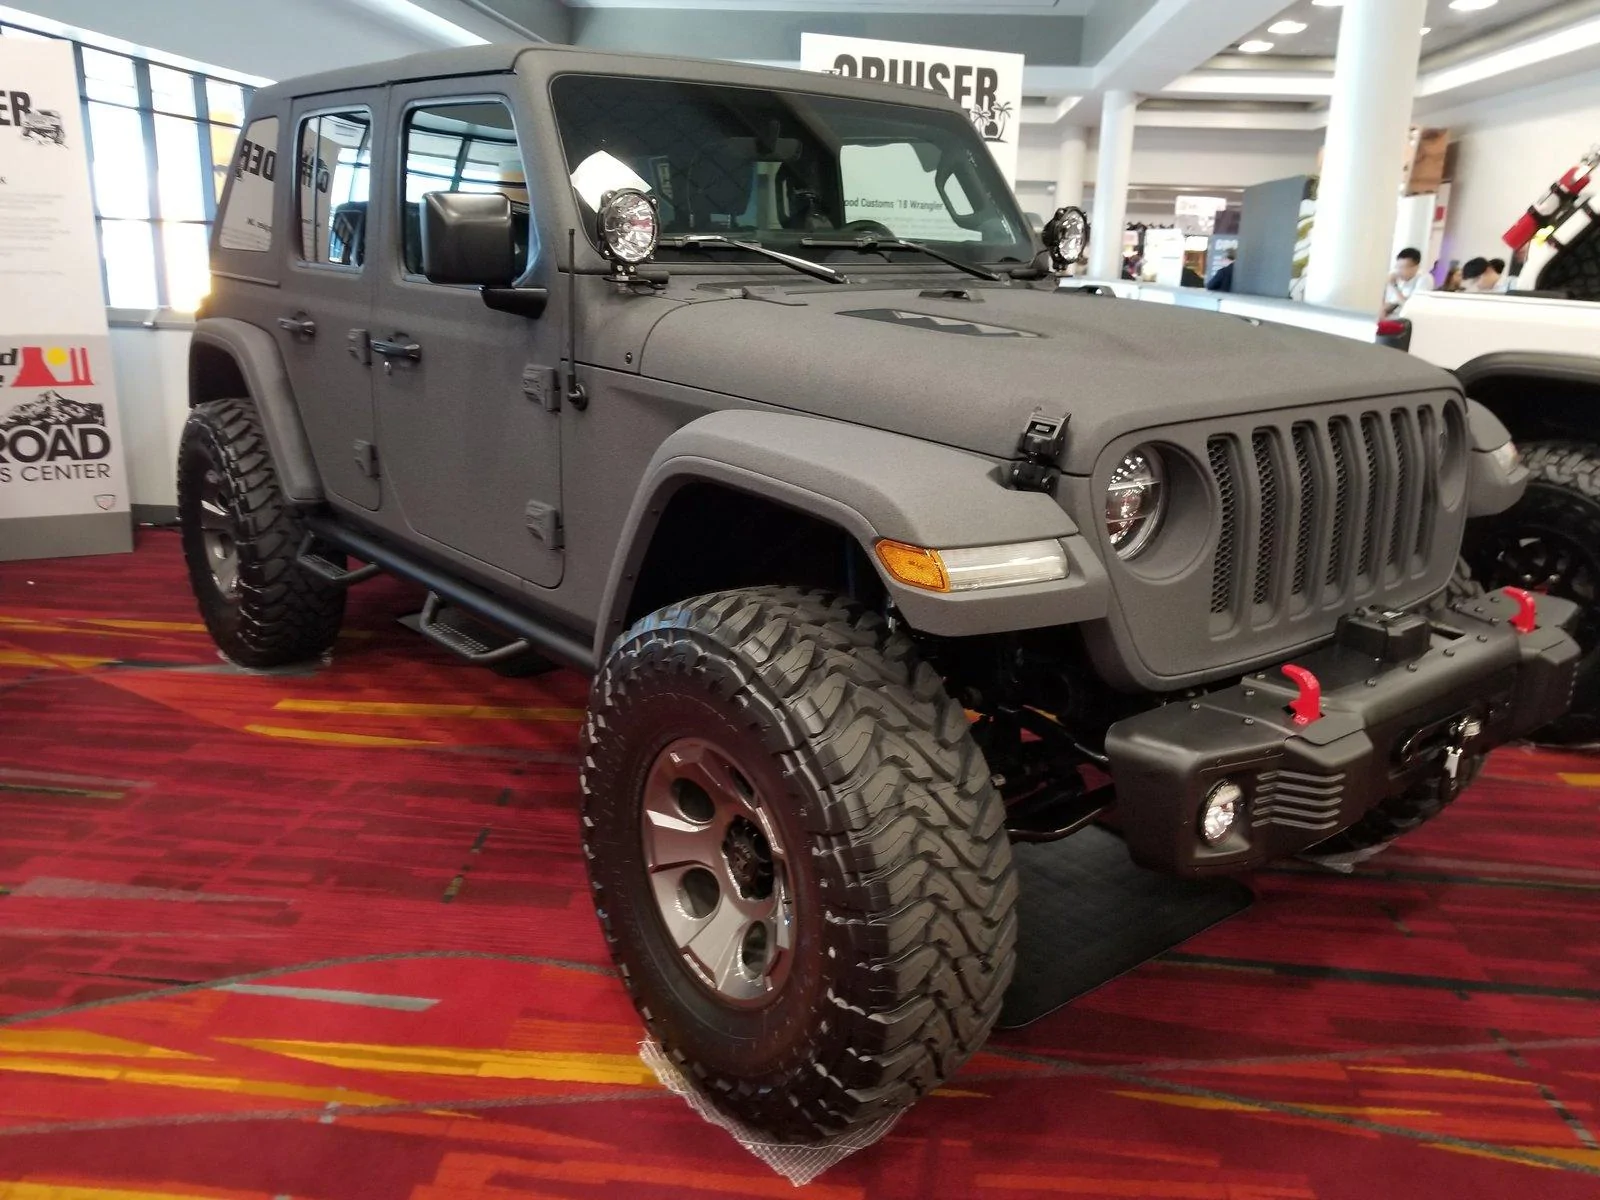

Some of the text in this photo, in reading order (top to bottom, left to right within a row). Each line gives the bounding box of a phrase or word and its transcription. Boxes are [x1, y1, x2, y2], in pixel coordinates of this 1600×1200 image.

[861, 198, 895, 209] Customs
[910, 199, 944, 212] Wrangler
[21, 463, 111, 482] CENTER
